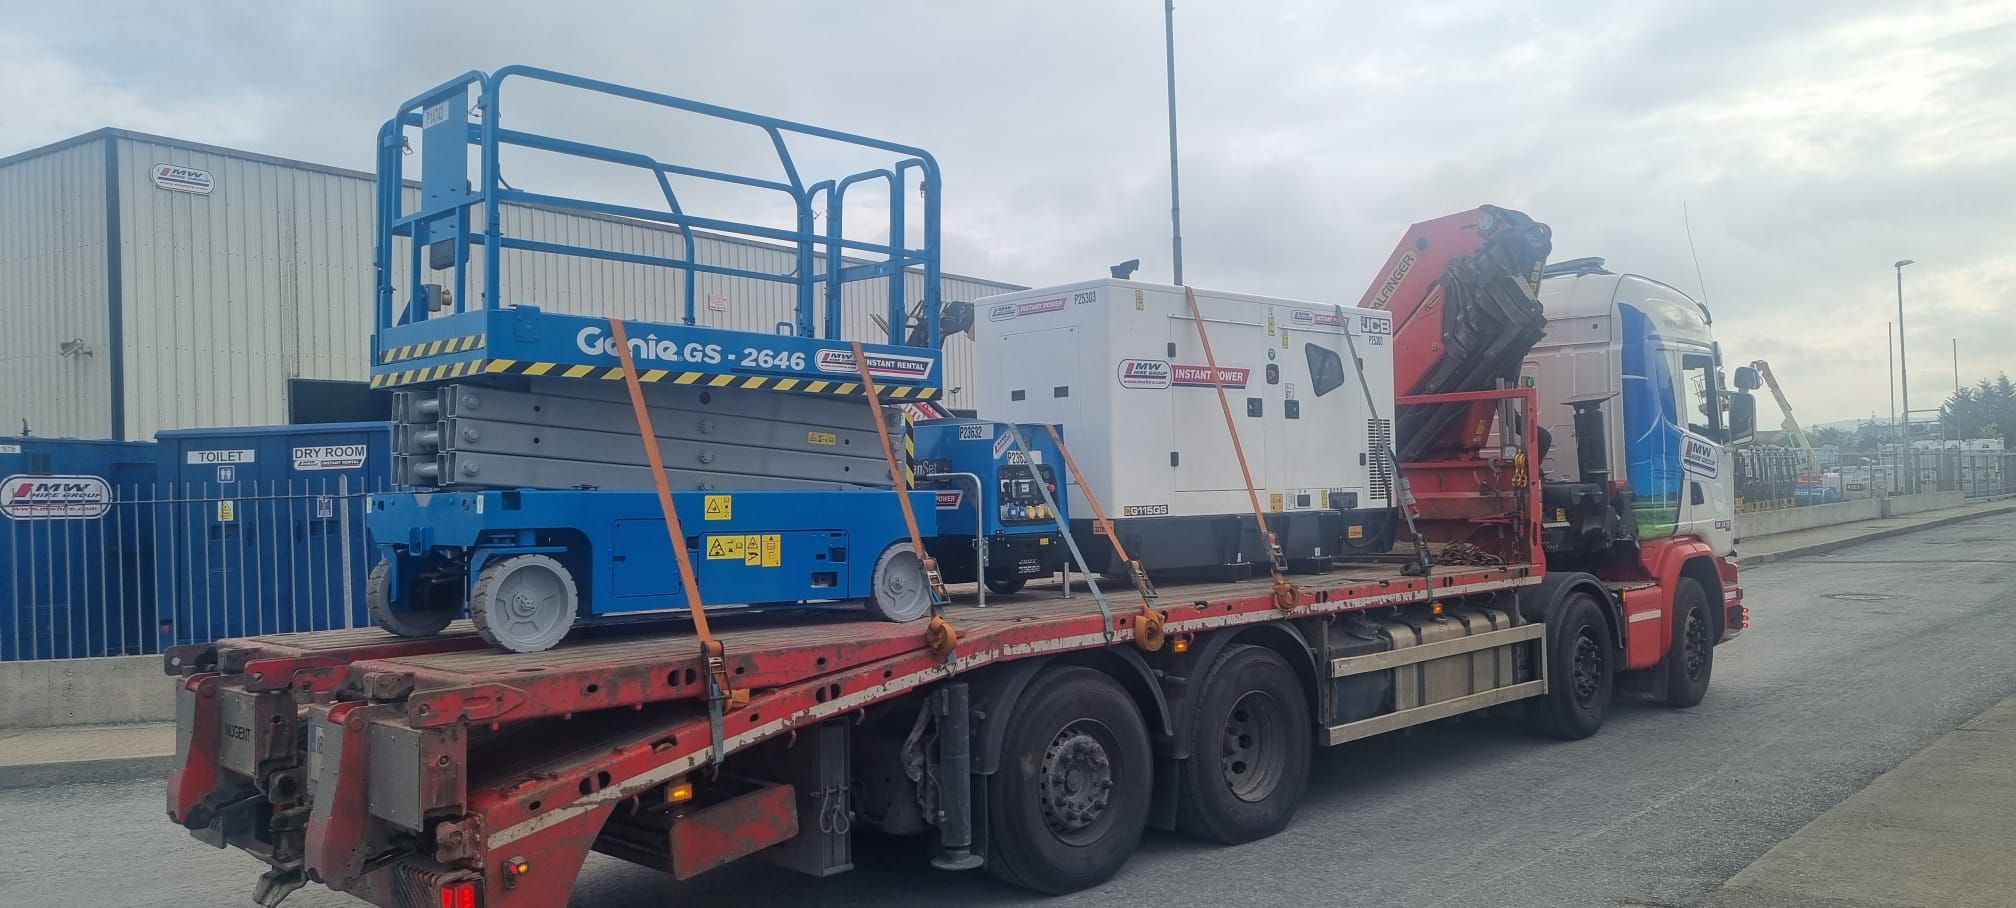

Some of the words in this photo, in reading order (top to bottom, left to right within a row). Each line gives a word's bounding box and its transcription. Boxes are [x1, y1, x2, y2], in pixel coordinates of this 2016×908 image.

[1371, 254, 1415, 309] ALFINGER
[1043, 300, 1063, 308] POWER
[1362, 317, 1391, 334] JCB
[684, 343, 722, 364] GS
[741, 348, 805, 370] 2646
[897, 360, 925, 370] RENTAL
[1135, 362, 1162, 370] MW
[1175, 369, 1211, 380] INSTANT
[959, 426, 982, 439] P23632
[295, 448, 321, 459] DRY
[325, 446, 365, 458] ROOM
[1692, 443, 1712, 457] MW
[199, 451, 244, 463] TOILET
[35, 483, 91, 492] MW
[225, 722, 251, 742] NUGENT
